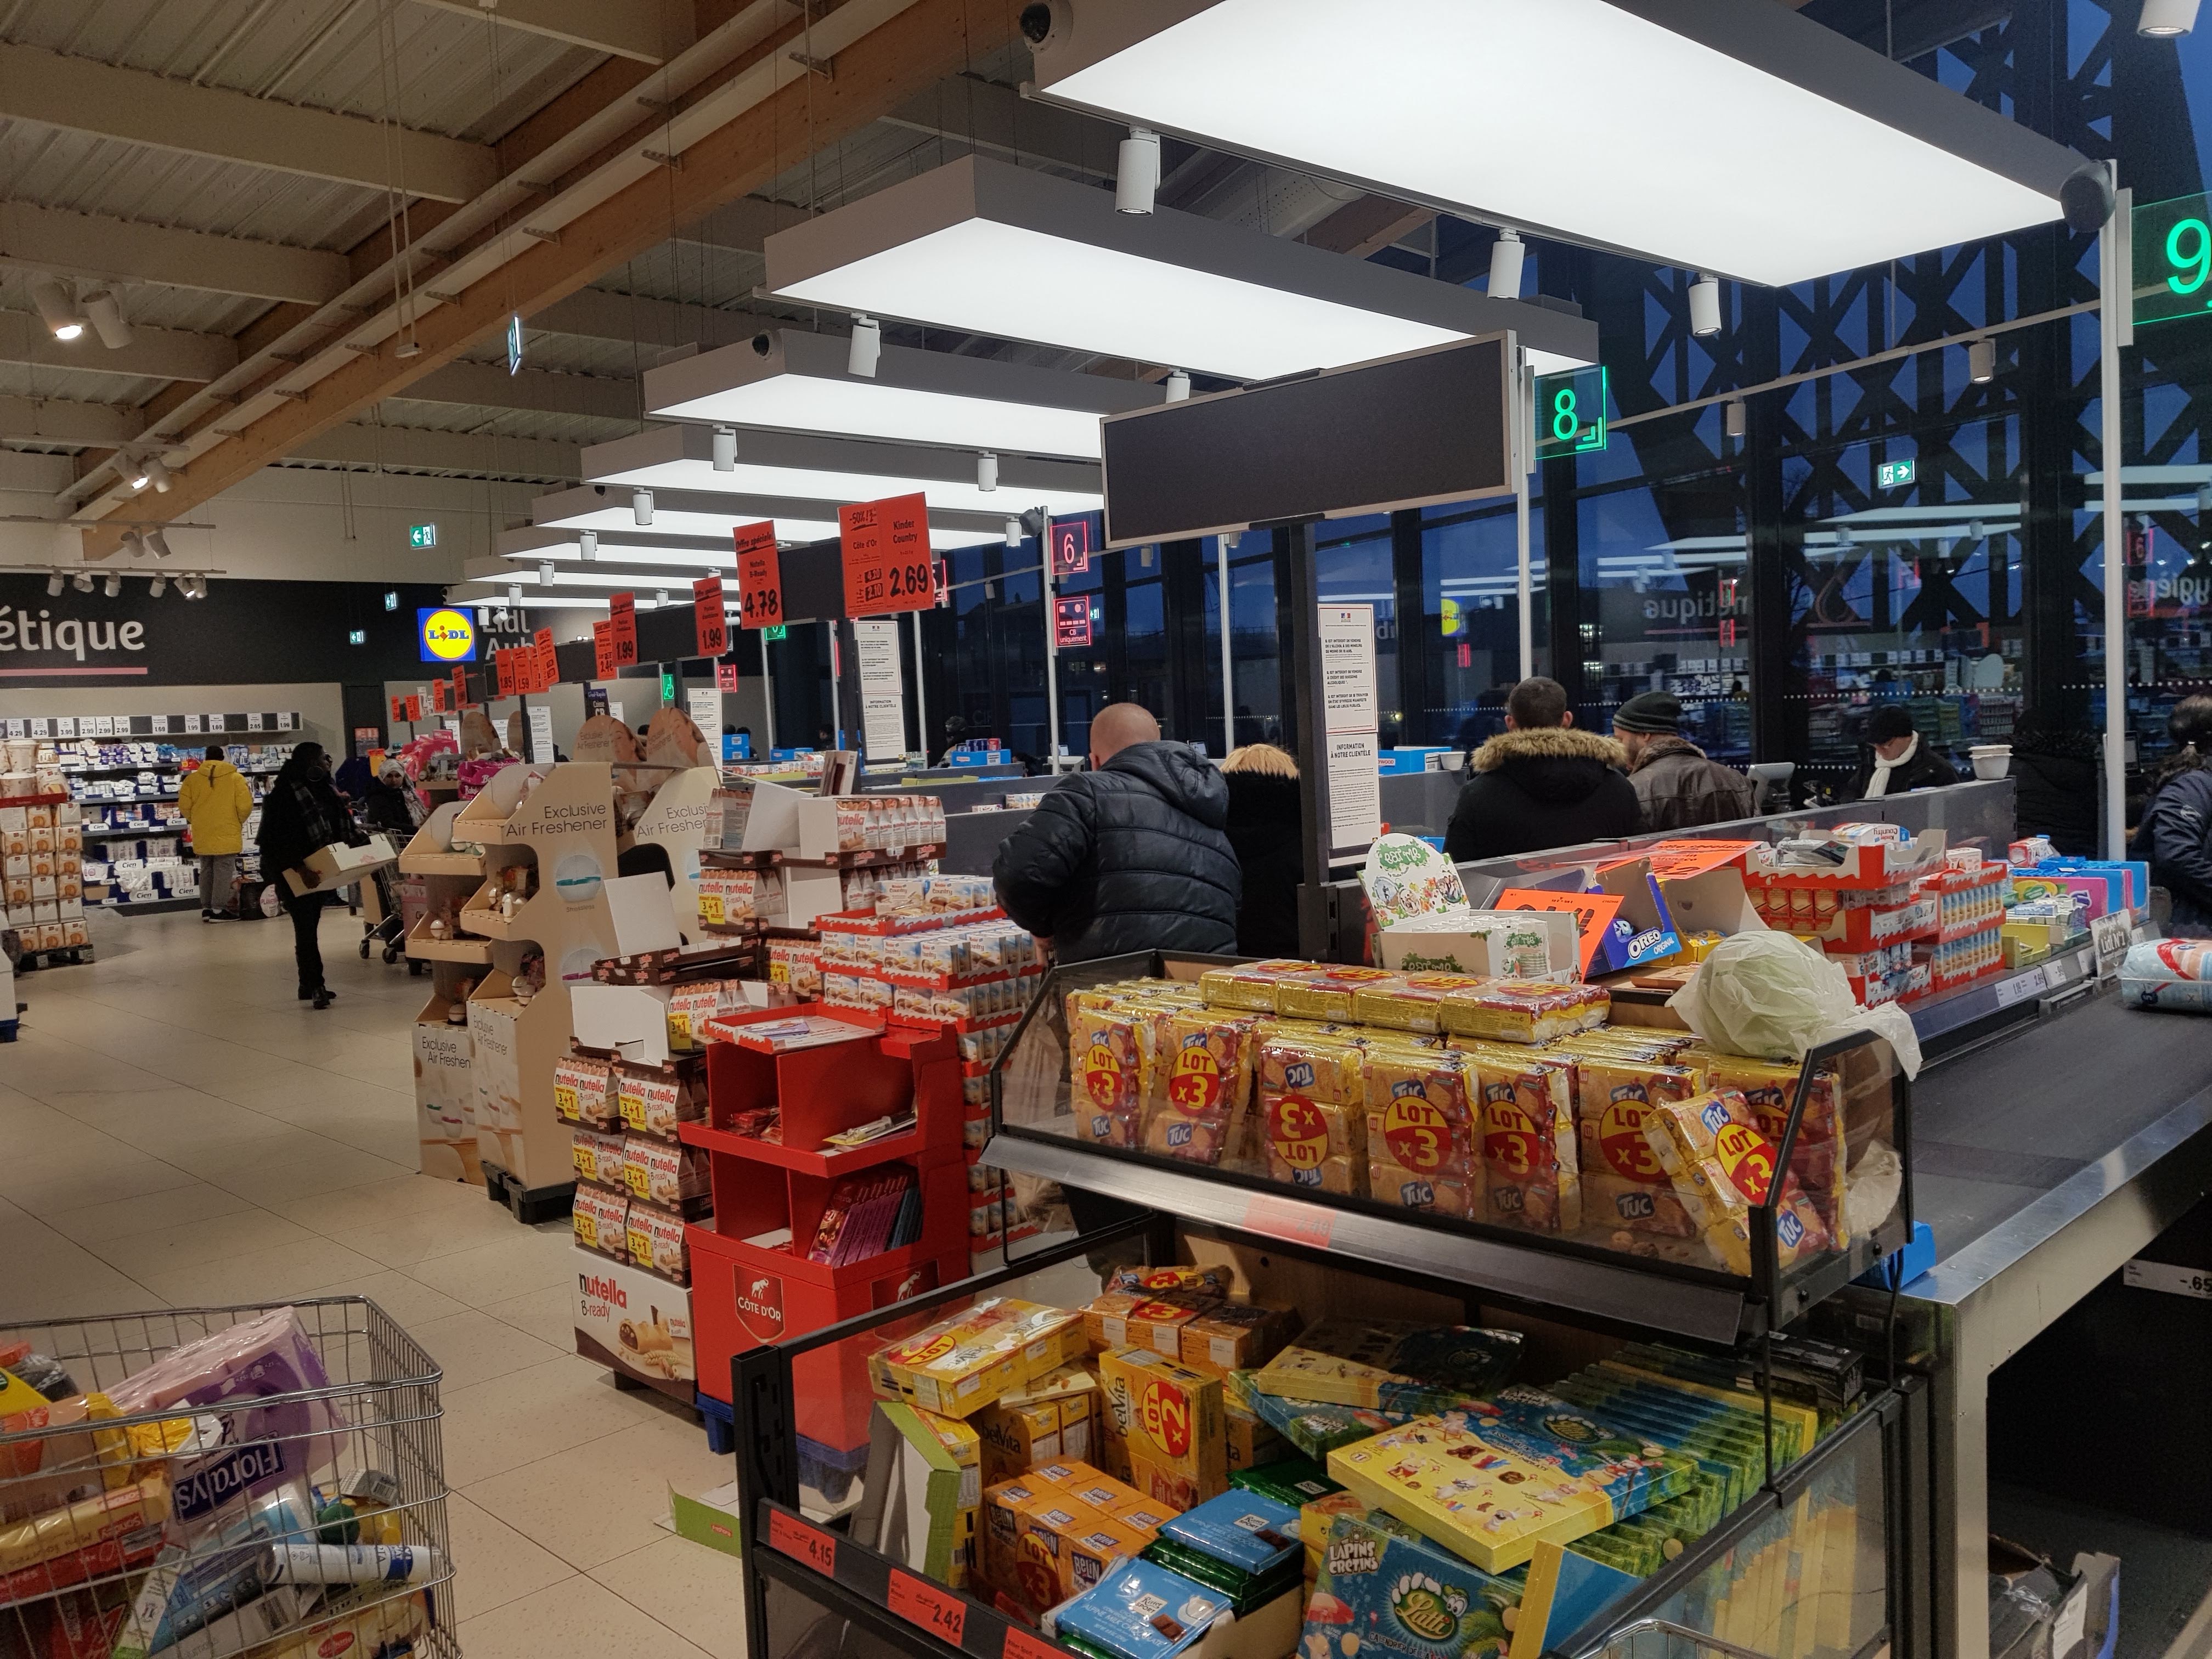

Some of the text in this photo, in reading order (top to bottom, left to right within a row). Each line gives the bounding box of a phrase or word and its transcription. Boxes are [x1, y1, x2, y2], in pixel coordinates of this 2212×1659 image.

[2166, 218, 2212, 294] 9
[1553, 389, 1578, 439] 8
[893, 520, 915, 531] Kinder
[853, 539, 877, 550] Côte d'Or
[893, 533, 918, 544] Country
[1064, 533, 1075, 563] 6
[889, 564, 928, 597] 2.69
[744, 588, 778, 618] 4.78
[0, 605, 145, 661] étique
[703, 627, 722, 650] 1.99
[616, 641, 634, 661] 1.99
[500, 676, 512, 689] 1.85
[517, 678, 529, 690] 1.59
[544, 804, 606, 819] Exclusive
[506, 819, 607, 837] Air Freshener
[636, 826, 654, 838] Air
[698, 882, 724, 893] nutella
[726, 883, 753, 895] nutella
[1628, 929, 1661, 959] OREO
[1654, 936, 1674, 955] ORIGINAL
[2100, 935, 2114, 953] Lidl
[670, 998, 691, 1012] nutella
[692, 995, 716, 1011] nutella
[473, 1015, 494, 1036] Exclusive
[422, 1036, 456, 1053] Exclusive
[427, 1051, 437, 1064] Air
[1092, 1049, 1113, 1069] LOT
[1182, 1052, 1211, 1071] LOT
[555, 1074, 579, 1087] nutella
[1286, 1064, 1313, 1084] TUC
[579, 1079, 605, 1093] nutella
[620, 1082, 646, 1097] nutella
[647, 1088, 675, 1104] nutella
[1092, 1073, 1115, 1105] x3
[1177, 1075, 1208, 1109] x3
[1279, 1102, 1316, 1139] x3
[1395, 1103, 1434, 1125] LOT
[1490, 1108, 1523, 1130] LOT
[1705, 1106, 1729, 1134] TUC
[1093, 1118, 1110, 1137] TUC
[1169, 1126, 1191, 1145] TUC
[573, 1133, 596, 1148] nutella
[597, 1140, 623, 1156] nutella
[1398, 1128, 1440, 1167] x3
[1720, 1130, 1753, 1157] LOT
[624, 1149, 650, 1166] nutella
[1285, 1143, 1318, 1163] LOT
[1493, 1135, 1529, 1175] x3
[650, 1158, 678, 1174] nutella
[1402, 1184, 1432, 1206] TUC
[1494, 1187, 1522, 1209] TUC
[574, 1199, 597, 1215] nutella
[598, 1207, 623, 1224] nutella
[1619, 1195, 1652, 1218] TUC
[628, 1216, 653, 1234] nutella
[653, 1225, 680, 1244] nutella
[1778, 1216, 1802, 1246] TUC
[579, 1273, 627, 1309] nutella
[580, 1300, 611, 1323] B-ready
[738, 1296, 781, 1322] CÔTE D'OR
[670, 1318, 686, 1328] nutella
[920, 1342, 950, 1362] LOT
[1108, 1376, 1129, 1438] belVita
[1148, 1396, 1159, 1436] LOT
[175, 1441, 279, 1510] Floralys
[809, 1539, 832, 1566] 4.15
[1329, 1541, 1376, 1560] LAPINS
[1135, 1602, 1157, 1615] SPORT
[1141, 1597, 1163, 1609] Ritter
[933, 1604, 961, 1634] 2.42
[1395, 1592, 1454, 1640] Lutti
[1369, 1633, 1406, 1654] CALENDRIER
